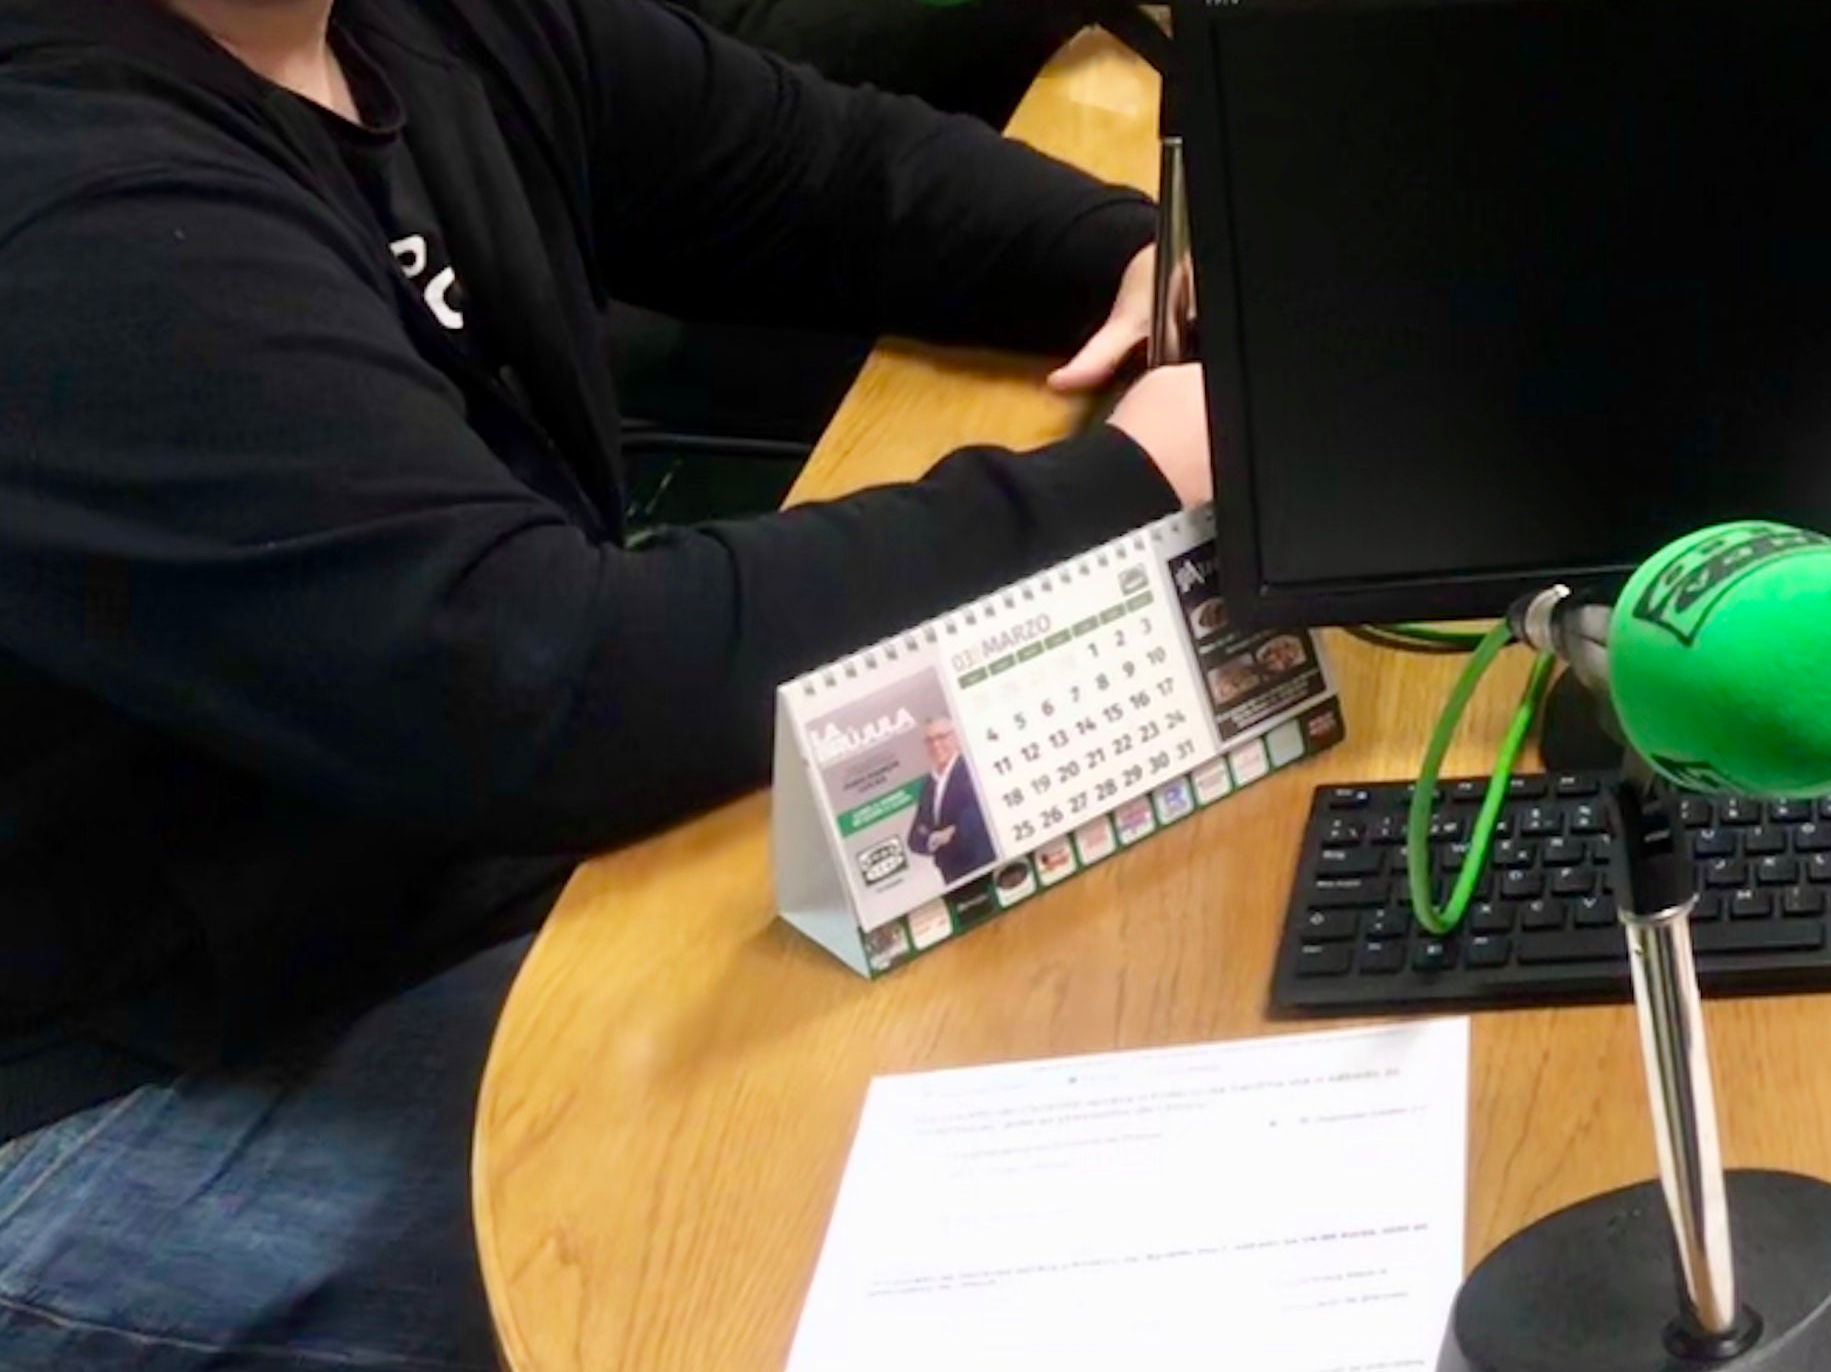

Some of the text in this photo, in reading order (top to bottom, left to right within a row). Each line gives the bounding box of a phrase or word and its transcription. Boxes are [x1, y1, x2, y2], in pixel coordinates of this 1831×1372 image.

[982, 613, 1051, 657] MARZO
[1146, 646, 1167, 665] 10
[993, 677, 1174, 774] 11 12 13 14 15 16 17
[1002, 710, 1186, 807] 18 19 20 21 22 23 24
[1012, 739, 1195, 842] 25 26 27 28 29 30 31
